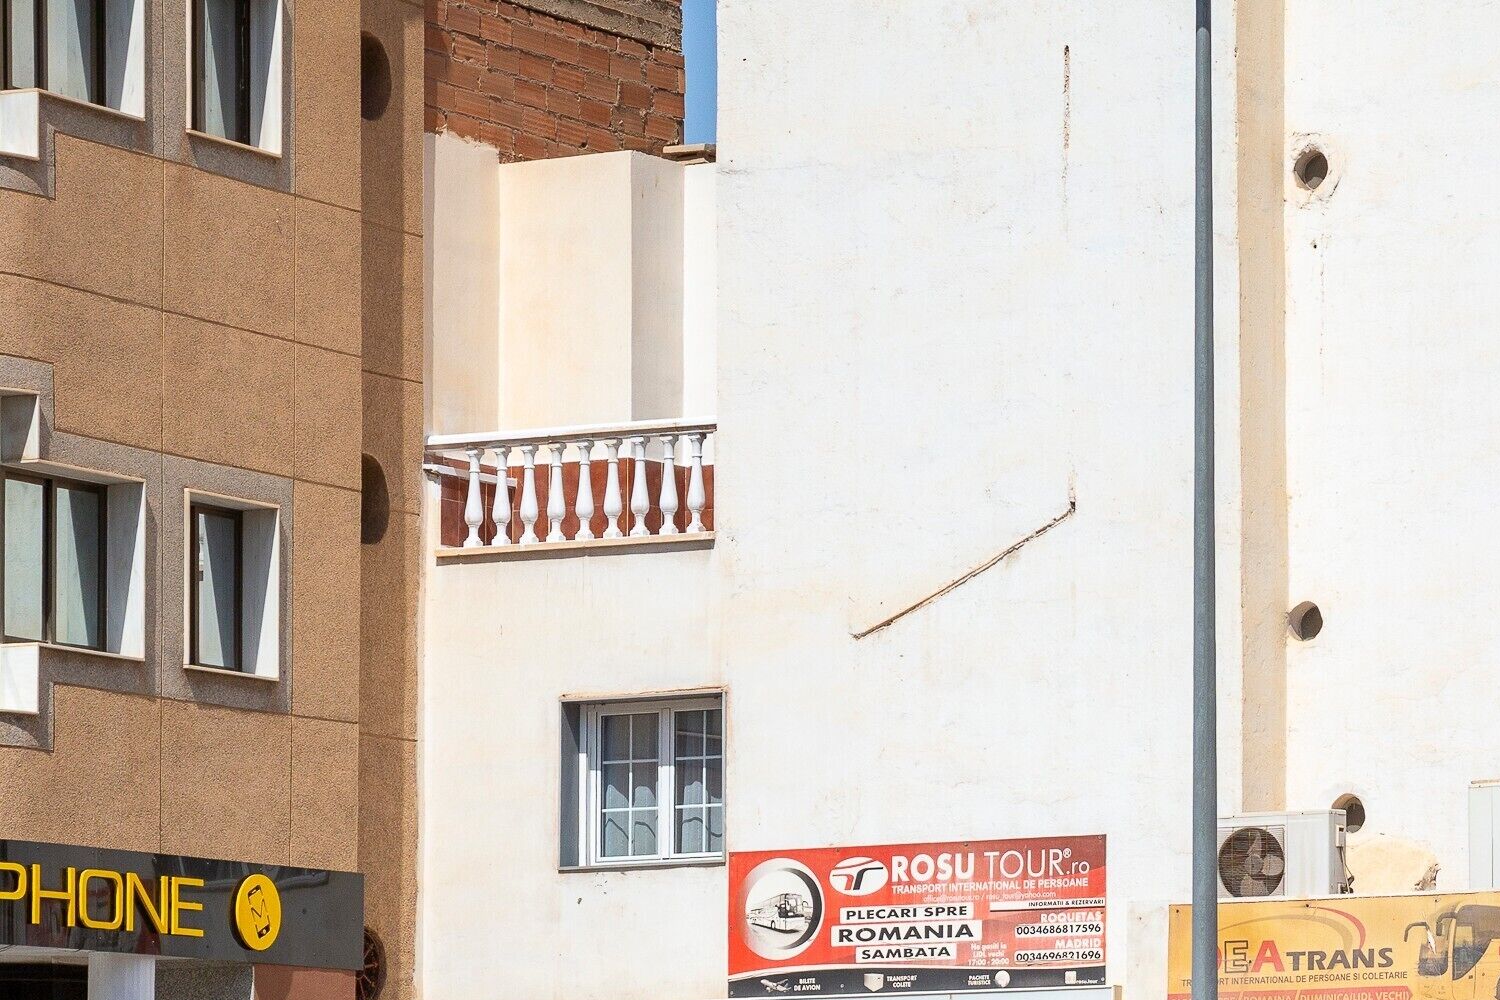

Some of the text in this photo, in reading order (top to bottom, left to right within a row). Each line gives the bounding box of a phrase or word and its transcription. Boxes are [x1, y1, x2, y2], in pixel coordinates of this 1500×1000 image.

[891, 852, 975, 883] ROSU
[891, 877, 1089, 895] TRANSPORT INTERNATIONAL DE PERSOANE
[0, 861, 204, 937] PHONE
[846, 905, 967, 920] PLECARI SPRE
[1040, 911, 1101, 923] ROQUETAS
[838, 923, 974, 943] ROMANIA
[1016, 923, 1101, 935] 0034686817596
[1055, 938, 1100, 949] MADRID
[861, 946, 951, 960] SAMBATA
[1231, 975, 1294, 985] INTERNATIONAL
[1295, 975, 1307, 984] DE
[1308, 973, 1352, 983] PERSOANE
[1352, 972, 1361, 981] SI
[1363, 971, 1408, 981] COLETARIE
